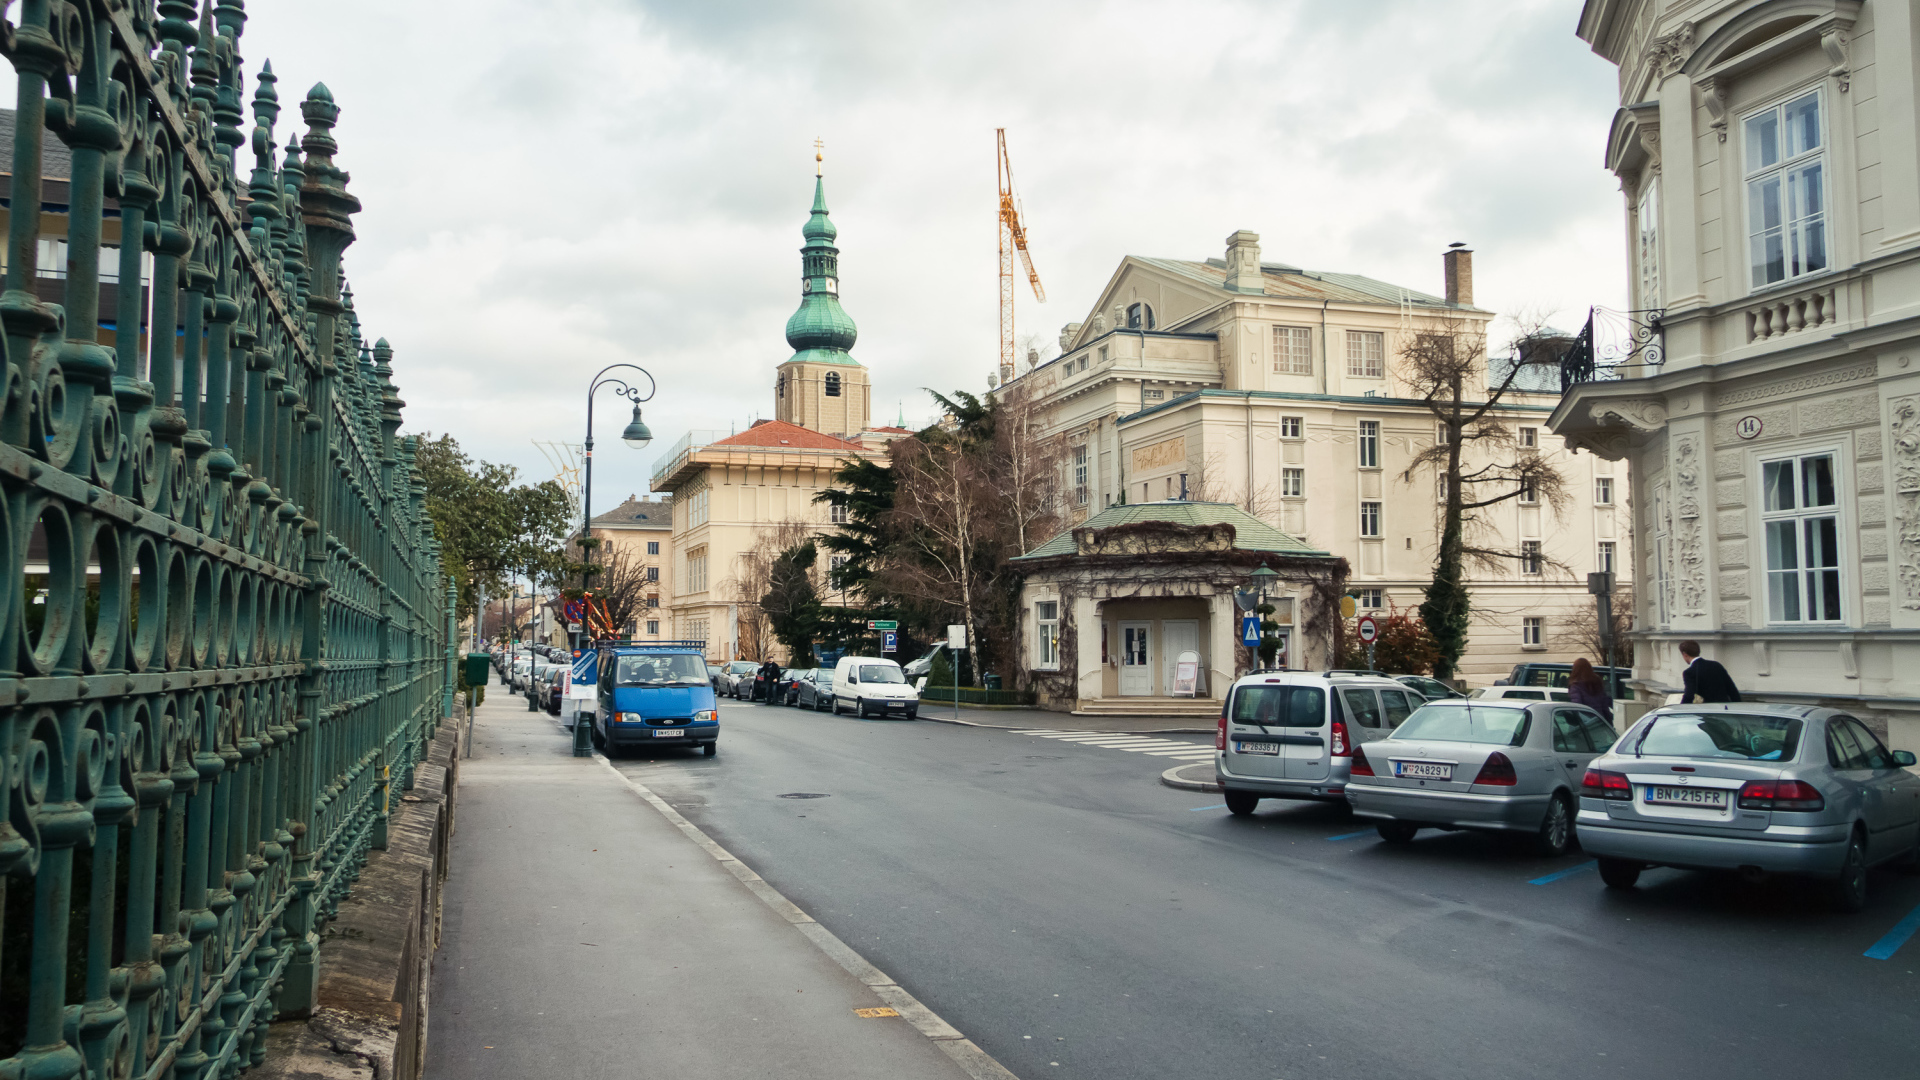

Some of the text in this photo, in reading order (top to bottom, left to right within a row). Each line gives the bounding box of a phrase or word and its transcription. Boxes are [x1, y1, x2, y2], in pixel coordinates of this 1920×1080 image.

[1743, 420, 1754, 433] 14
[886, 634, 894, 645] P
[1250, 743, 1271, 751] 26336
[1402, 764, 1449, 776] W 24829 Y
[1656, 788, 1673, 800] BN
